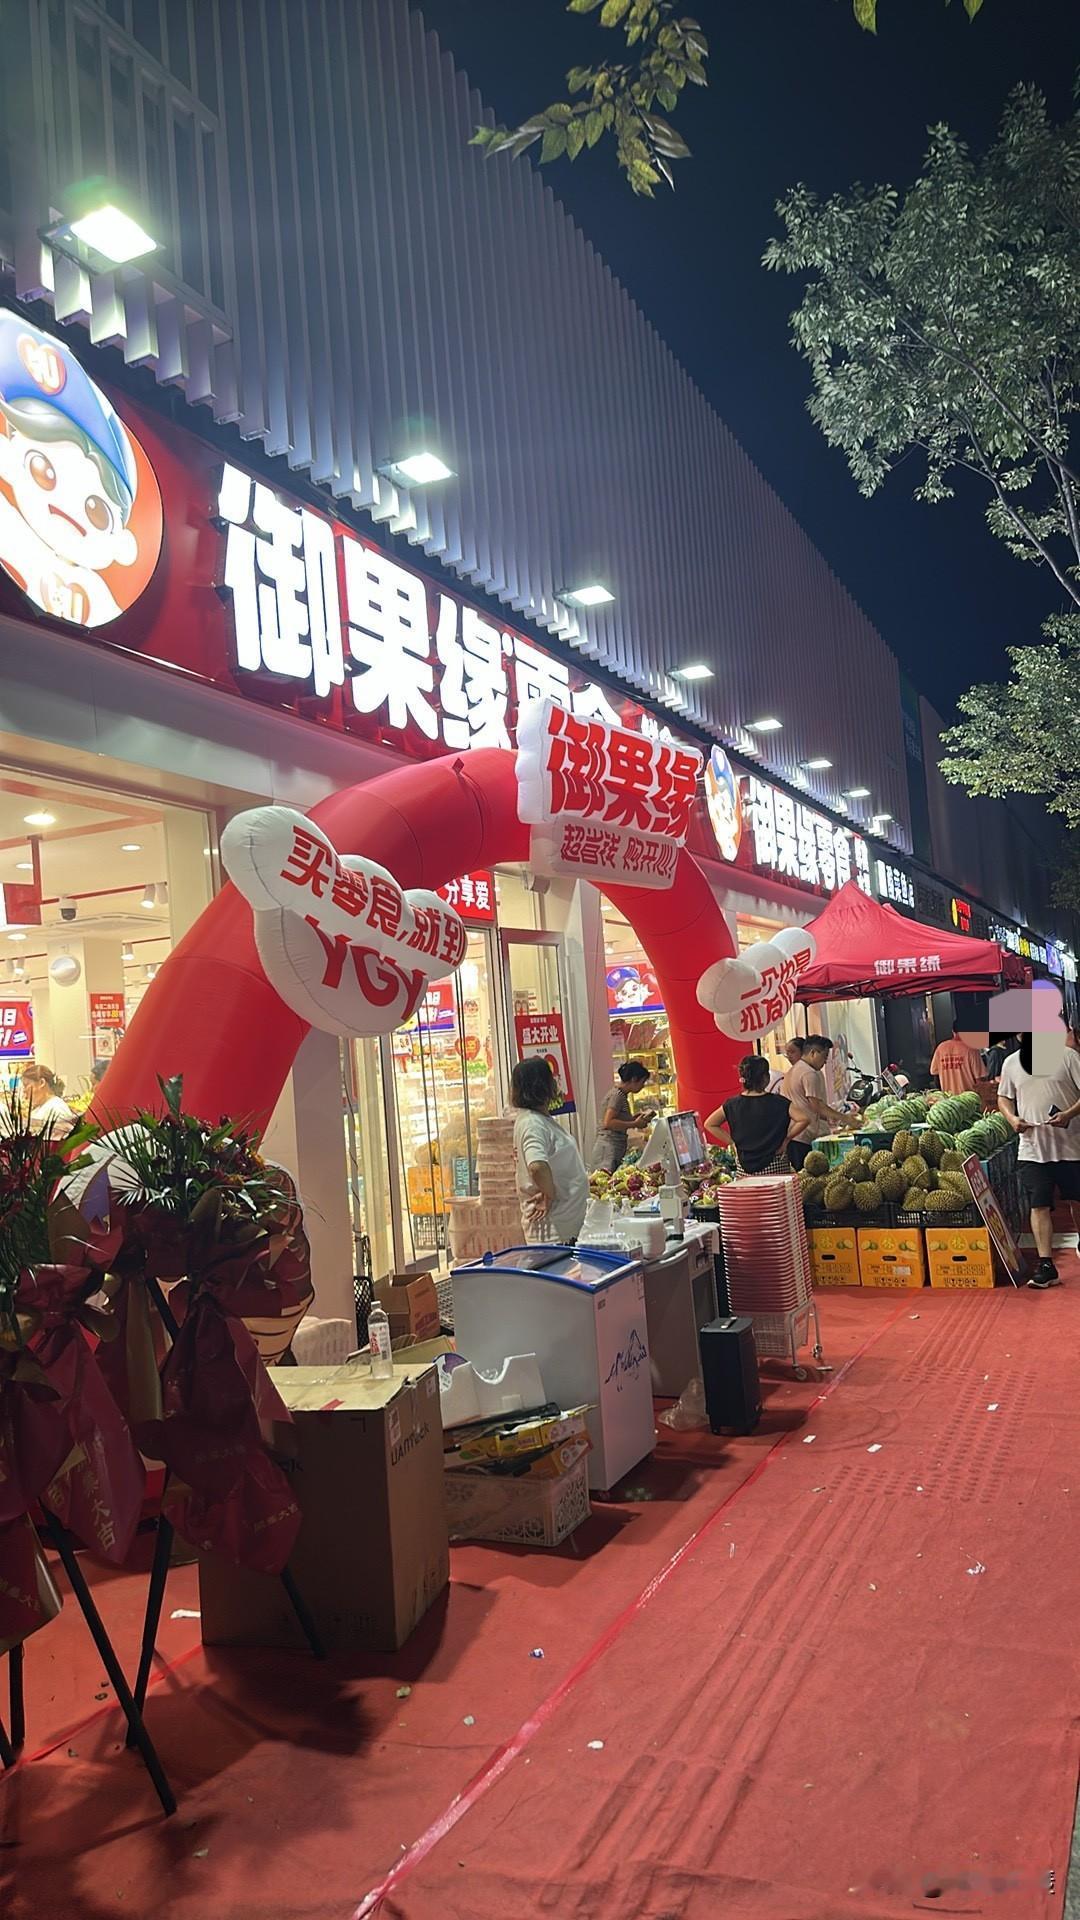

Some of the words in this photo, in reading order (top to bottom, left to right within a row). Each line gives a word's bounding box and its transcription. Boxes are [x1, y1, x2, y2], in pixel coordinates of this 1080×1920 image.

[547, 706, 699, 838] 御果缘
[561, 823, 621, 868] 超省钱
[305, 914, 427, 1021] YGY
[874, 955, 942, 976] 御果缘
[522, 1025, 559, 1045] 盛大开业
